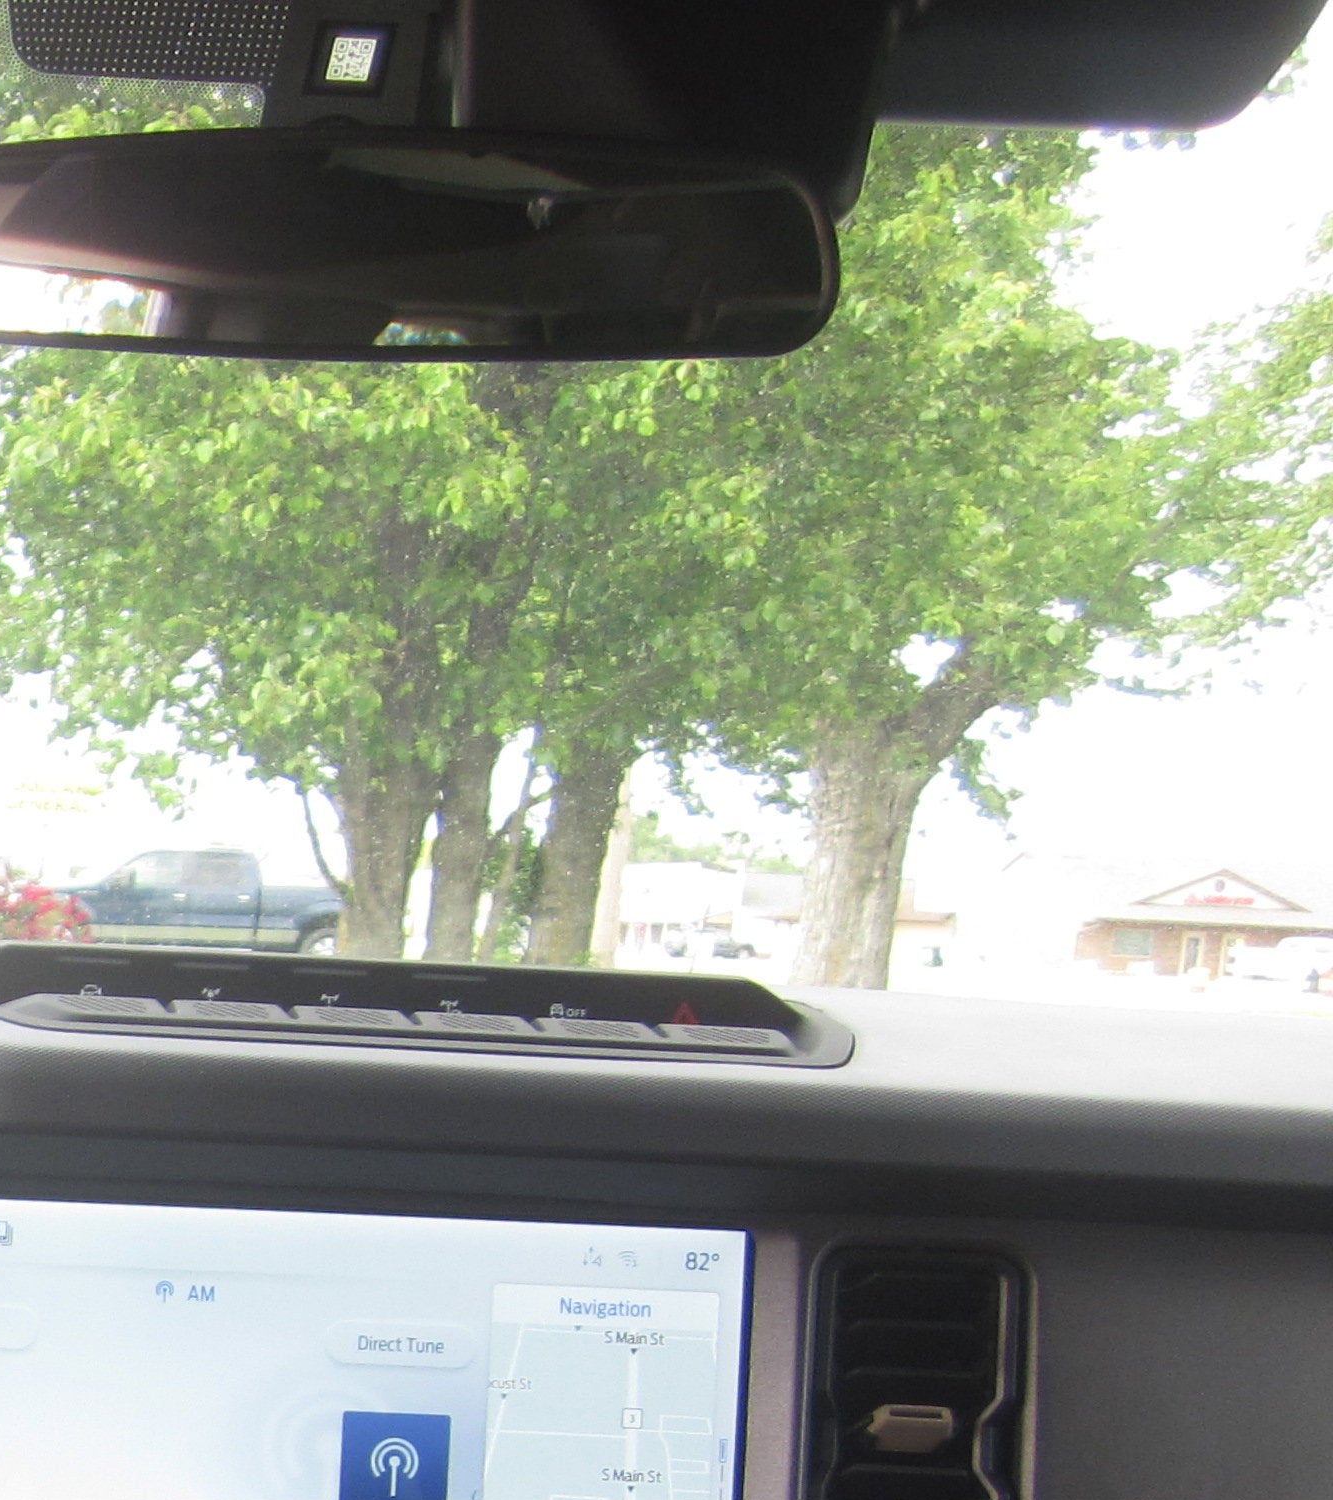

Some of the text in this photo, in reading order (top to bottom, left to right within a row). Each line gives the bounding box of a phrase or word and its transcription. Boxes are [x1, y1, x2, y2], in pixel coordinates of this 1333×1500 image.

[566, 1007, 587, 1018] OFF
[187, 1285, 216, 1303] AM
[559, 1297, 652, 1319] Navigation
[357, 1335, 445, 1355] Direct Tune
[604, 1331, 665, 1347] S Main St
[519, 1377, 532, 1390] St
[601, 1469, 662, 1484] S Main St
